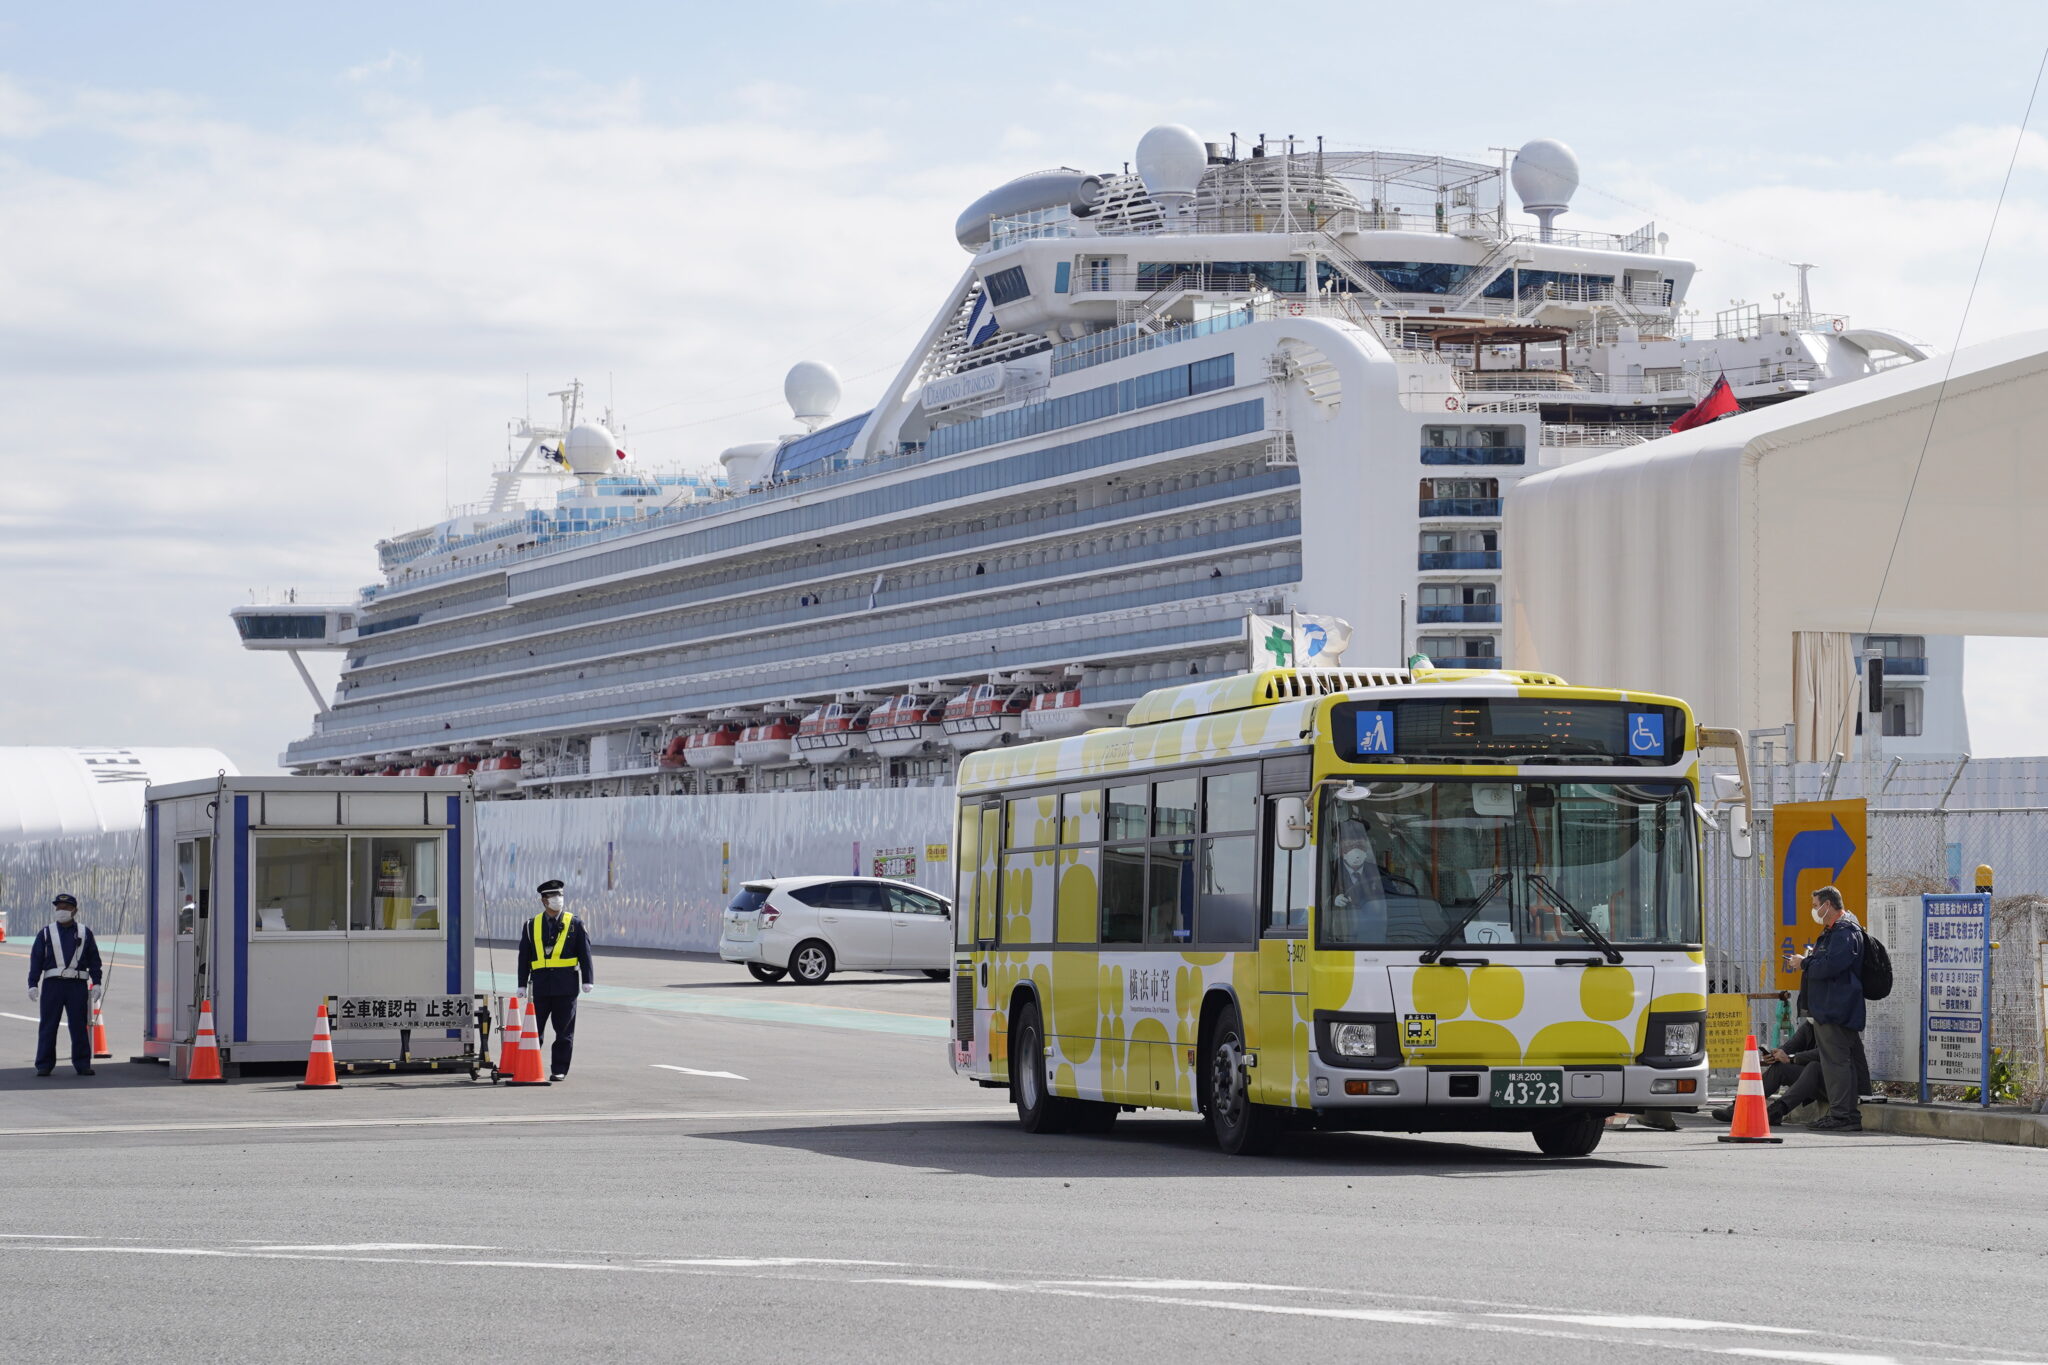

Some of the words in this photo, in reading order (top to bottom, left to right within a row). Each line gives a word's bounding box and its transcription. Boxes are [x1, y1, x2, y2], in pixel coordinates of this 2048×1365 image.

[927, 383, 960, 405] DIAMOND
[962, 373, 996, 396] PRINCESS
[1130, 969, 1169, 1002] 横浜市営
[341, 1000, 417, 1018] 全車確認中
[425, 1000, 471, 1018] 止まれ
[1503, 1082, 1560, 1104] 43-23
